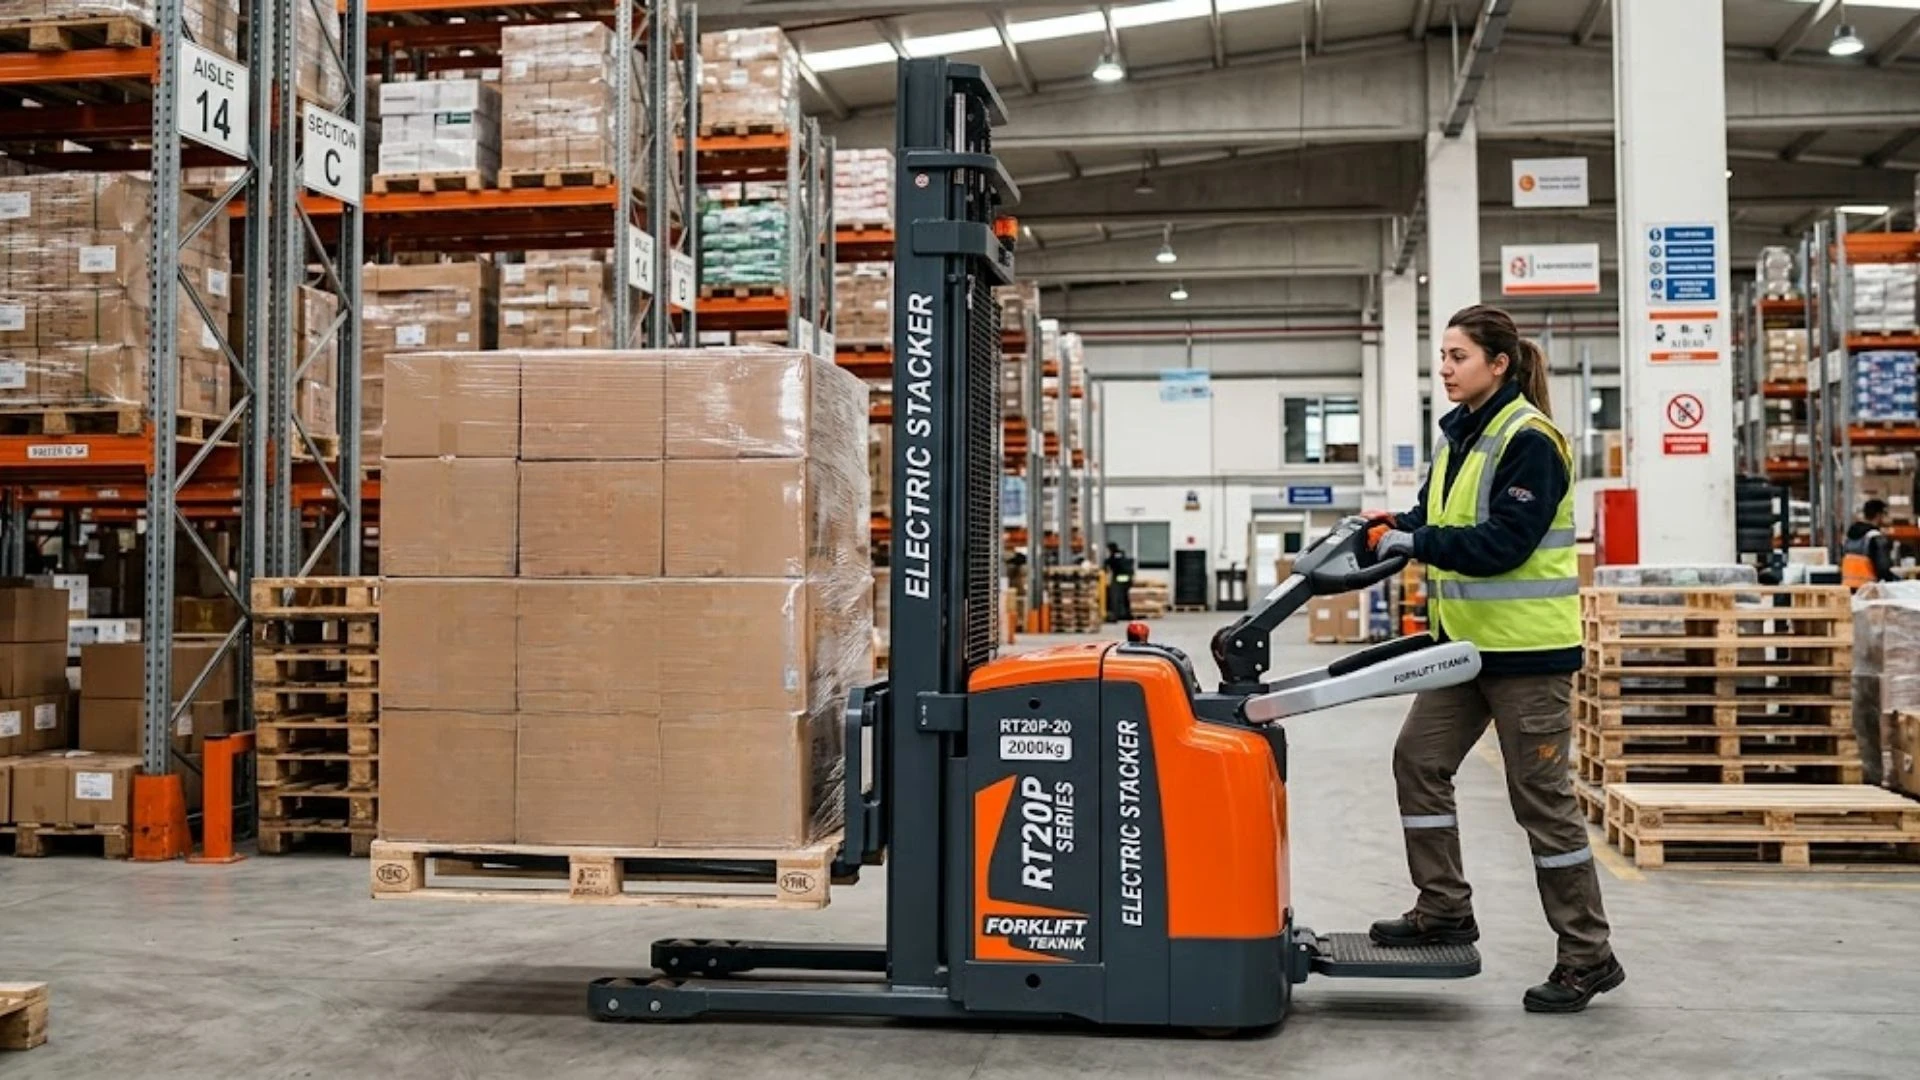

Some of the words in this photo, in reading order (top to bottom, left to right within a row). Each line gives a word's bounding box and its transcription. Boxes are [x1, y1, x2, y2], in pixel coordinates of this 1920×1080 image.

[193, 57, 235, 90] AISLE
[196, 88, 231, 141] 14
[324, 148, 341, 187] C
[906, 293, 934, 438] STACKER
[905, 446, 932, 599] ELECTRIC
[999, 718, 1073, 734] RT20P-20
[1007, 739, 1065, 758] 2000kg
[1117, 720, 1141, 819] STACKER
[1021, 775, 1054, 892] RT20P
[1055, 781, 1075, 853] SERIES
[1119, 823, 1143, 926] ELECTRIC
[985, 917, 1089, 935] FORKLIFT
